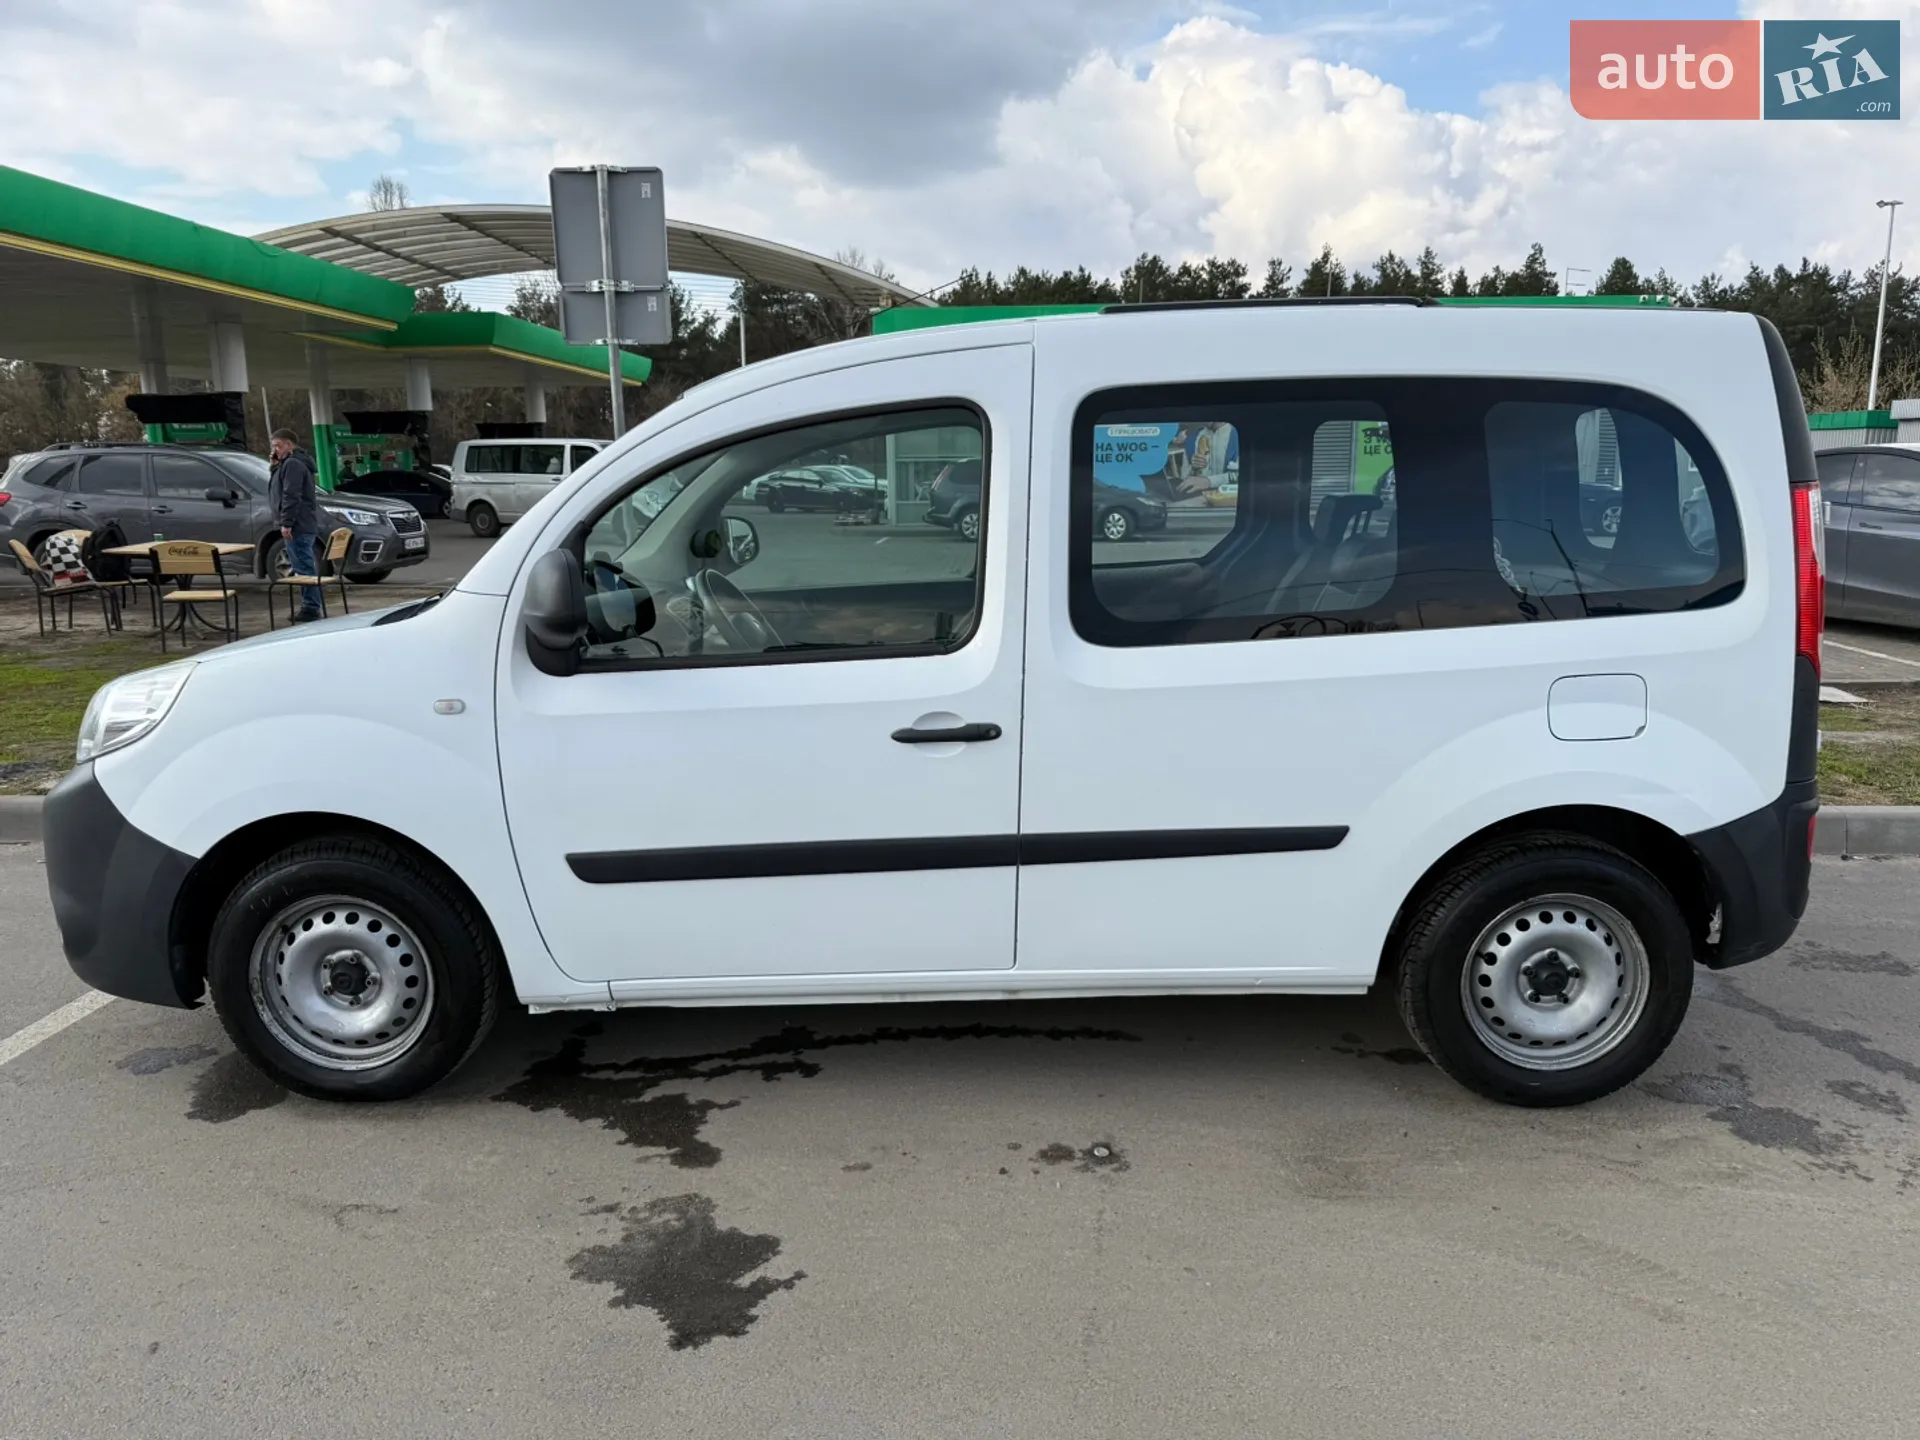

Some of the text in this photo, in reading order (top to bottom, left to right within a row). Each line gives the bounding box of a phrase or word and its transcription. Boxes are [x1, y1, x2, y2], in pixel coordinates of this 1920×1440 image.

[1096, 442, 1113, 452] НА
[1116, 442, 1148, 452] WOG
[1364, 445, 1380, 456] ЦЕ
[1096, 453, 1134, 464] ЦЕ ОК
